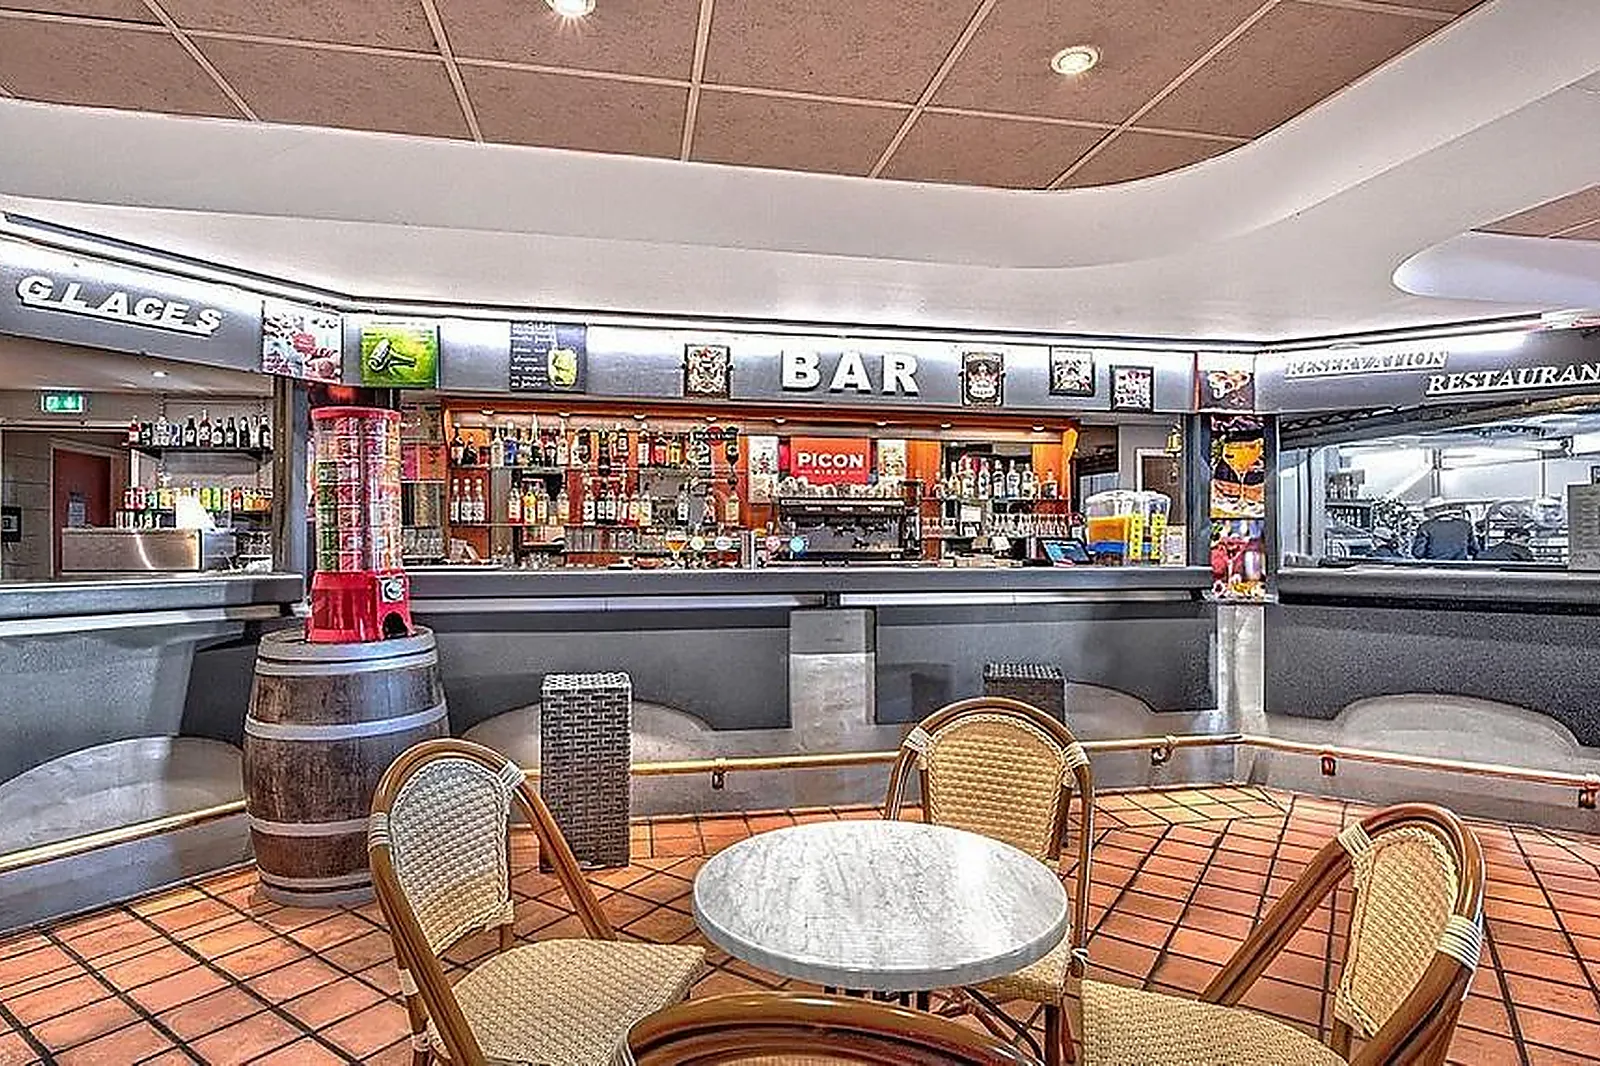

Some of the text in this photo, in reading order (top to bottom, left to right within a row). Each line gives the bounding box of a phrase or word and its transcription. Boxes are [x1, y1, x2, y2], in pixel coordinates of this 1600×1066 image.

[17, 275, 223, 334] GLACES
[780, 349, 920, 396] BAR
[797, 452, 864, 468] PICON
